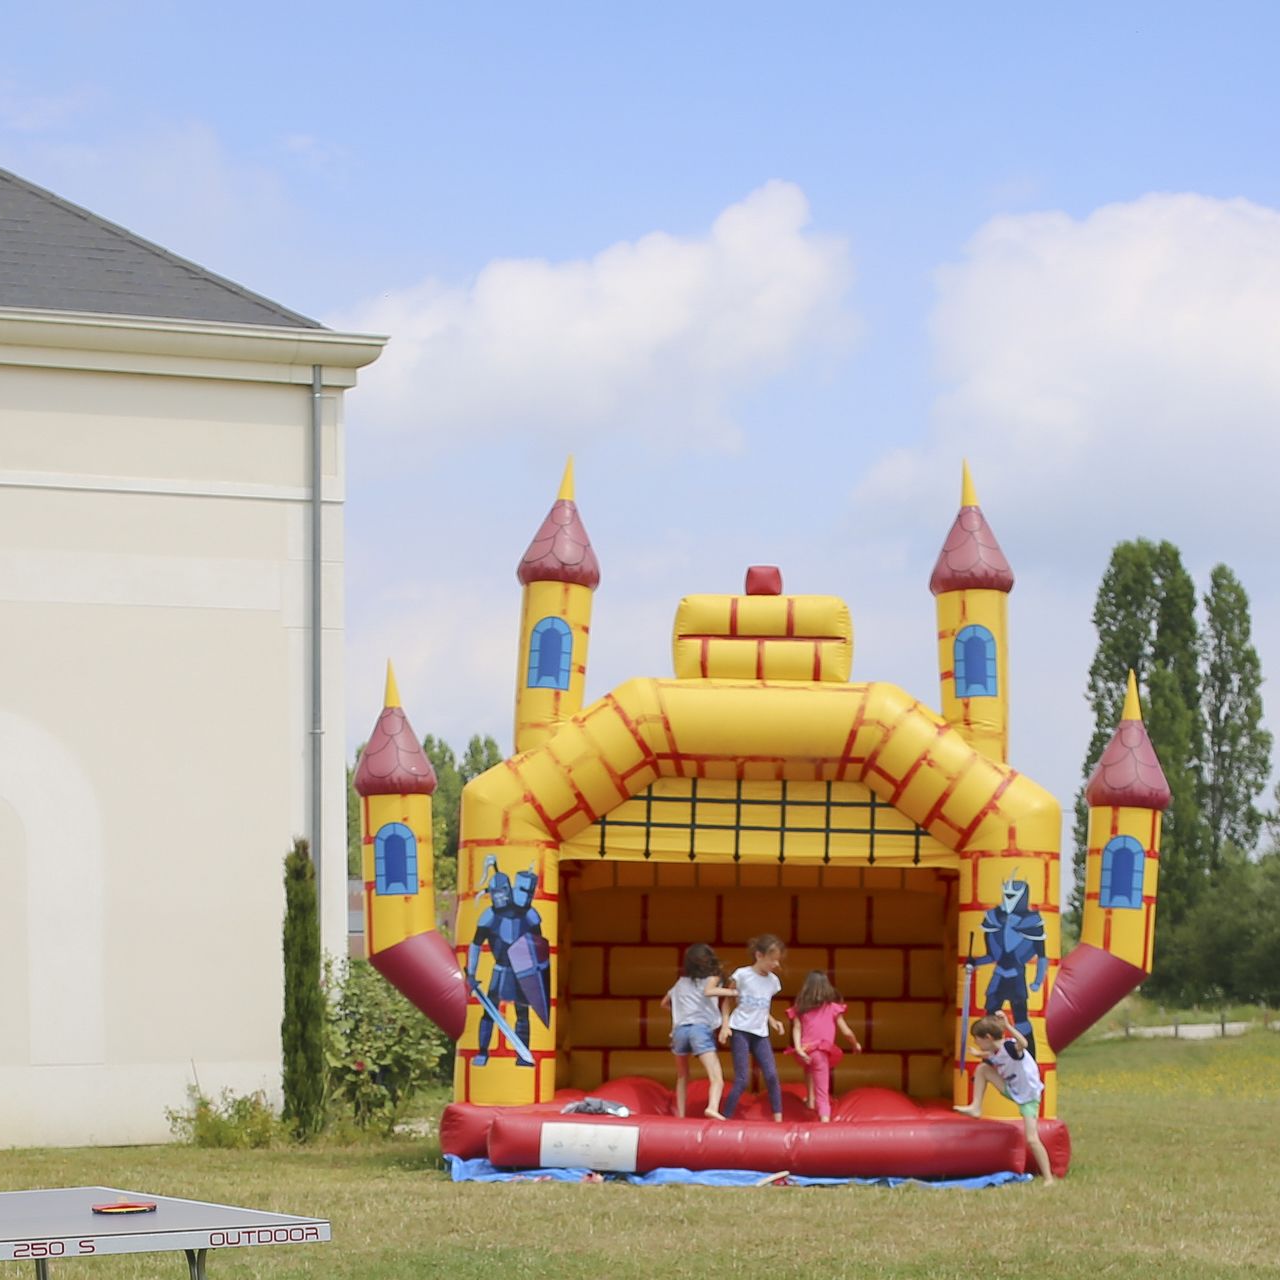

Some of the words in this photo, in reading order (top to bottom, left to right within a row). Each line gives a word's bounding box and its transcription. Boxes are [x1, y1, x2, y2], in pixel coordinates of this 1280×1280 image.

[209, 1227, 319, 1246] OUTDOOR
[13, 1241, 65, 1258] 250
[79, 1240, 96, 1254] S
